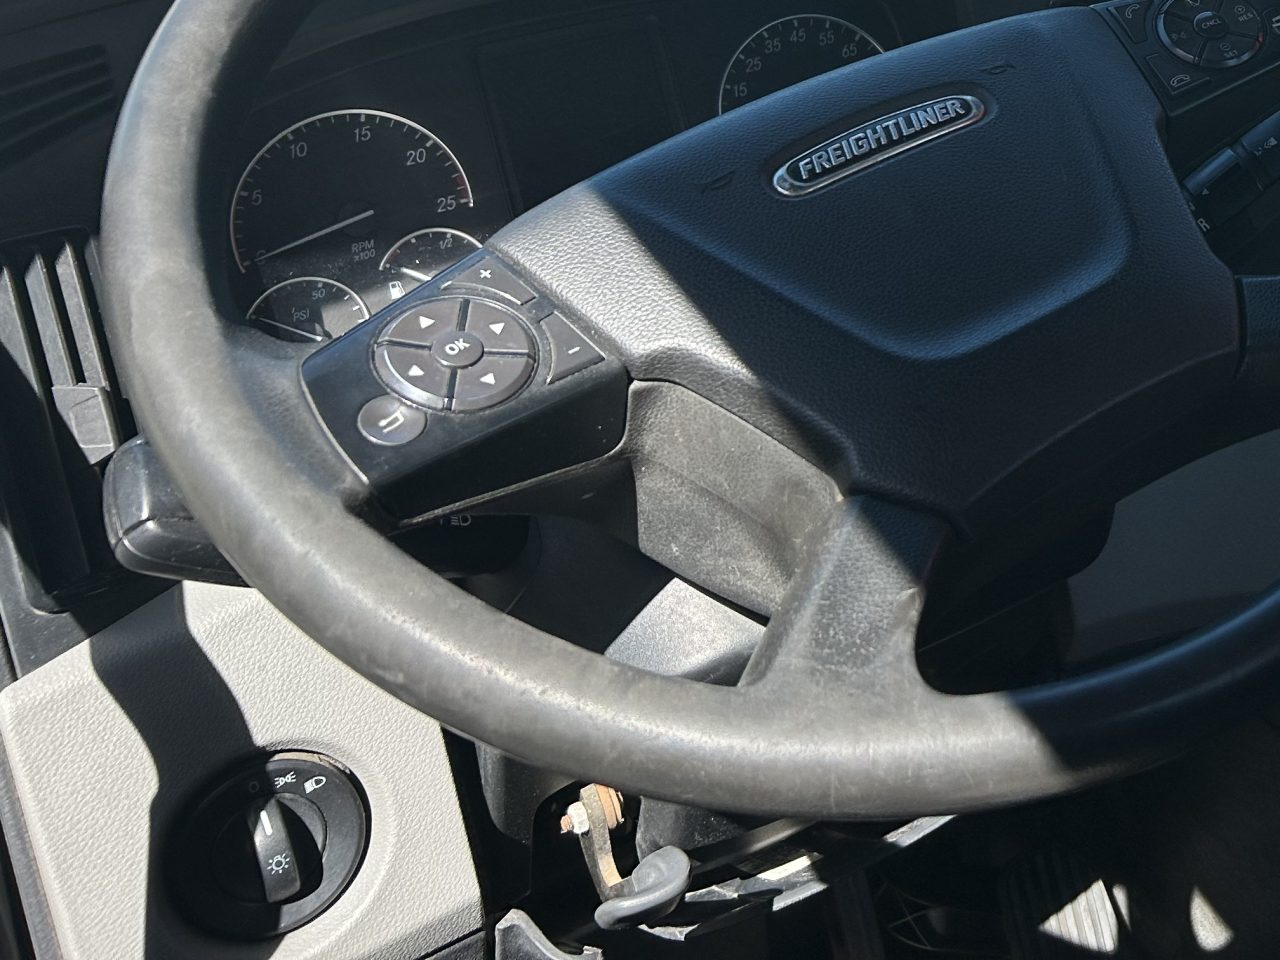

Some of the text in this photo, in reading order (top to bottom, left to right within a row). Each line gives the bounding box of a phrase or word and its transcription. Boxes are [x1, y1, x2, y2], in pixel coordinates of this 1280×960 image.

[790, 28, 806, 43] 45
[818, 30, 835, 46] 55
[764, 38, 781, 54] 35
[842, 43, 858, 58] 65
[745, 56, 762, 73] 25
[733, 82, 748, 98] 15
[353, 126, 371, 143] 15
[798, 99, 966, 180] FREIGHTLINER
[290, 142, 308, 159] 10
[406, 148, 426, 166] 20
[252, 190, 262, 206] 5
[436, 195, 456, 213] 25
[1197, 217, 1211, 233] R
[352, 239, 375, 253] RPM
[439, 237, 453, 249] 1/2
[311, 289, 326, 301] 50
[294, 308, 310, 321] PSI
[444, 337, 471, 356] OK
